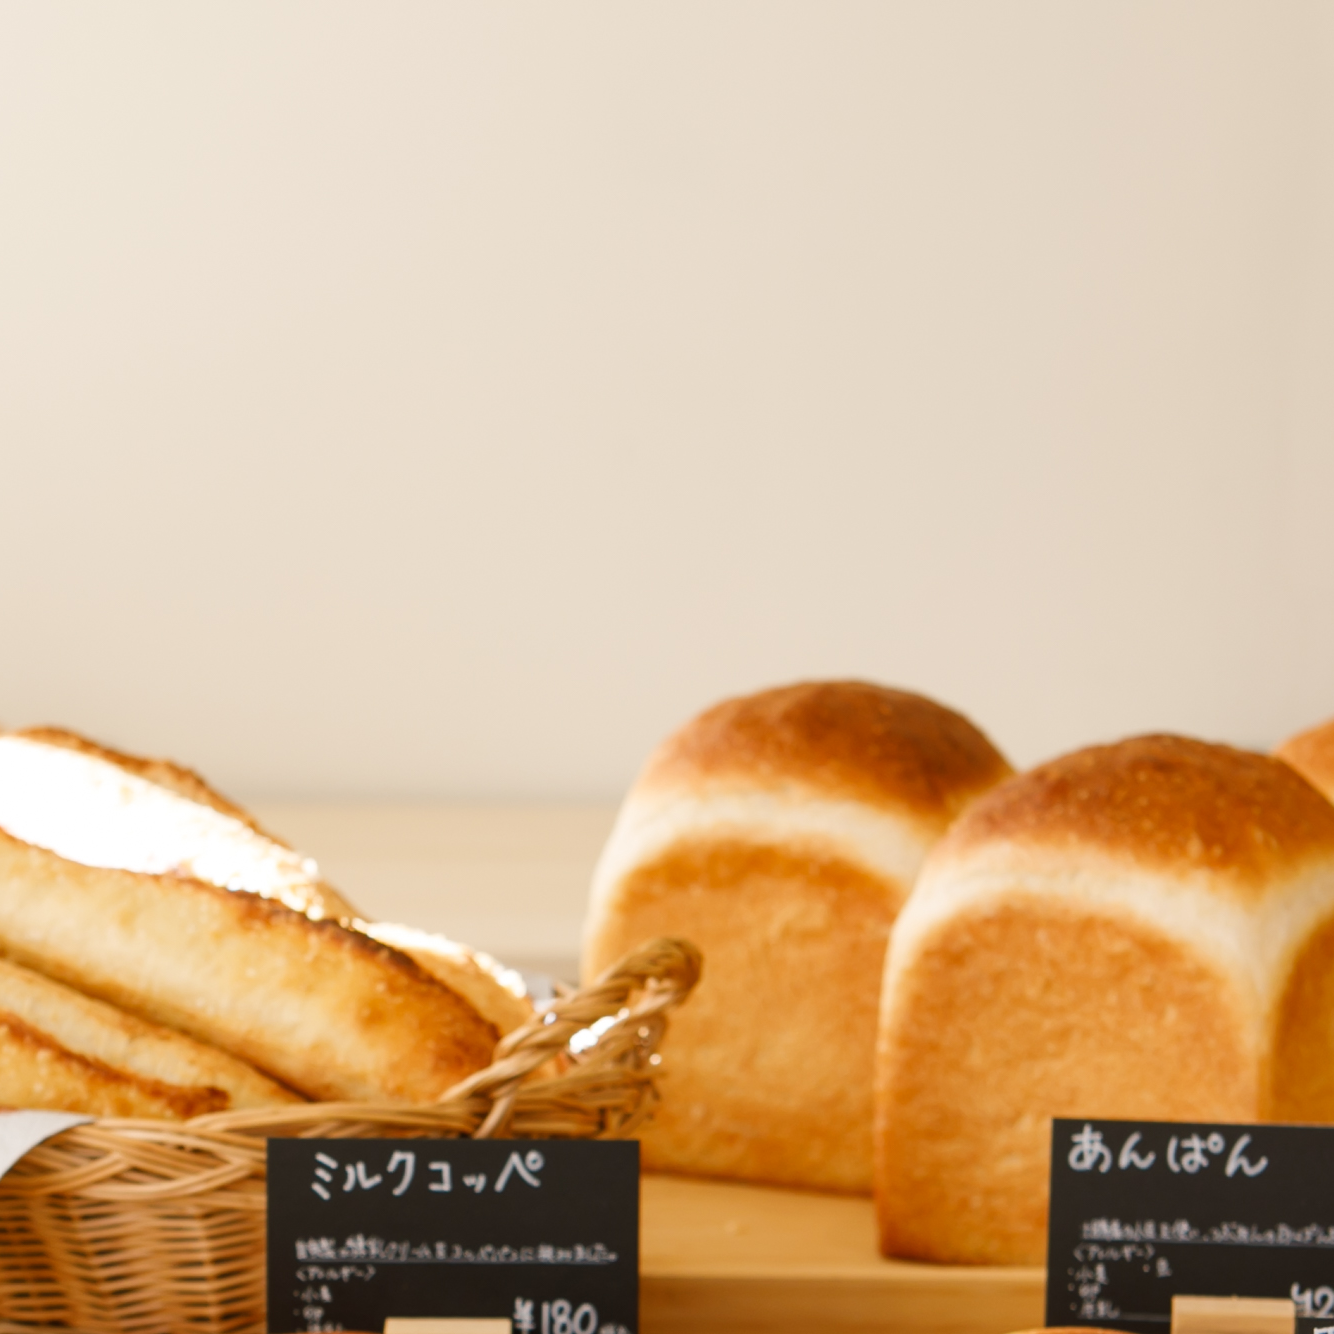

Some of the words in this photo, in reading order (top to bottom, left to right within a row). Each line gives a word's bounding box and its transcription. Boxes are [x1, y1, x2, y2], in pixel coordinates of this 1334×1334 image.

[309, 1150, 545, 1201] ミルクコッペ
[1067, 1123, 1269, 1178] あんぱん
